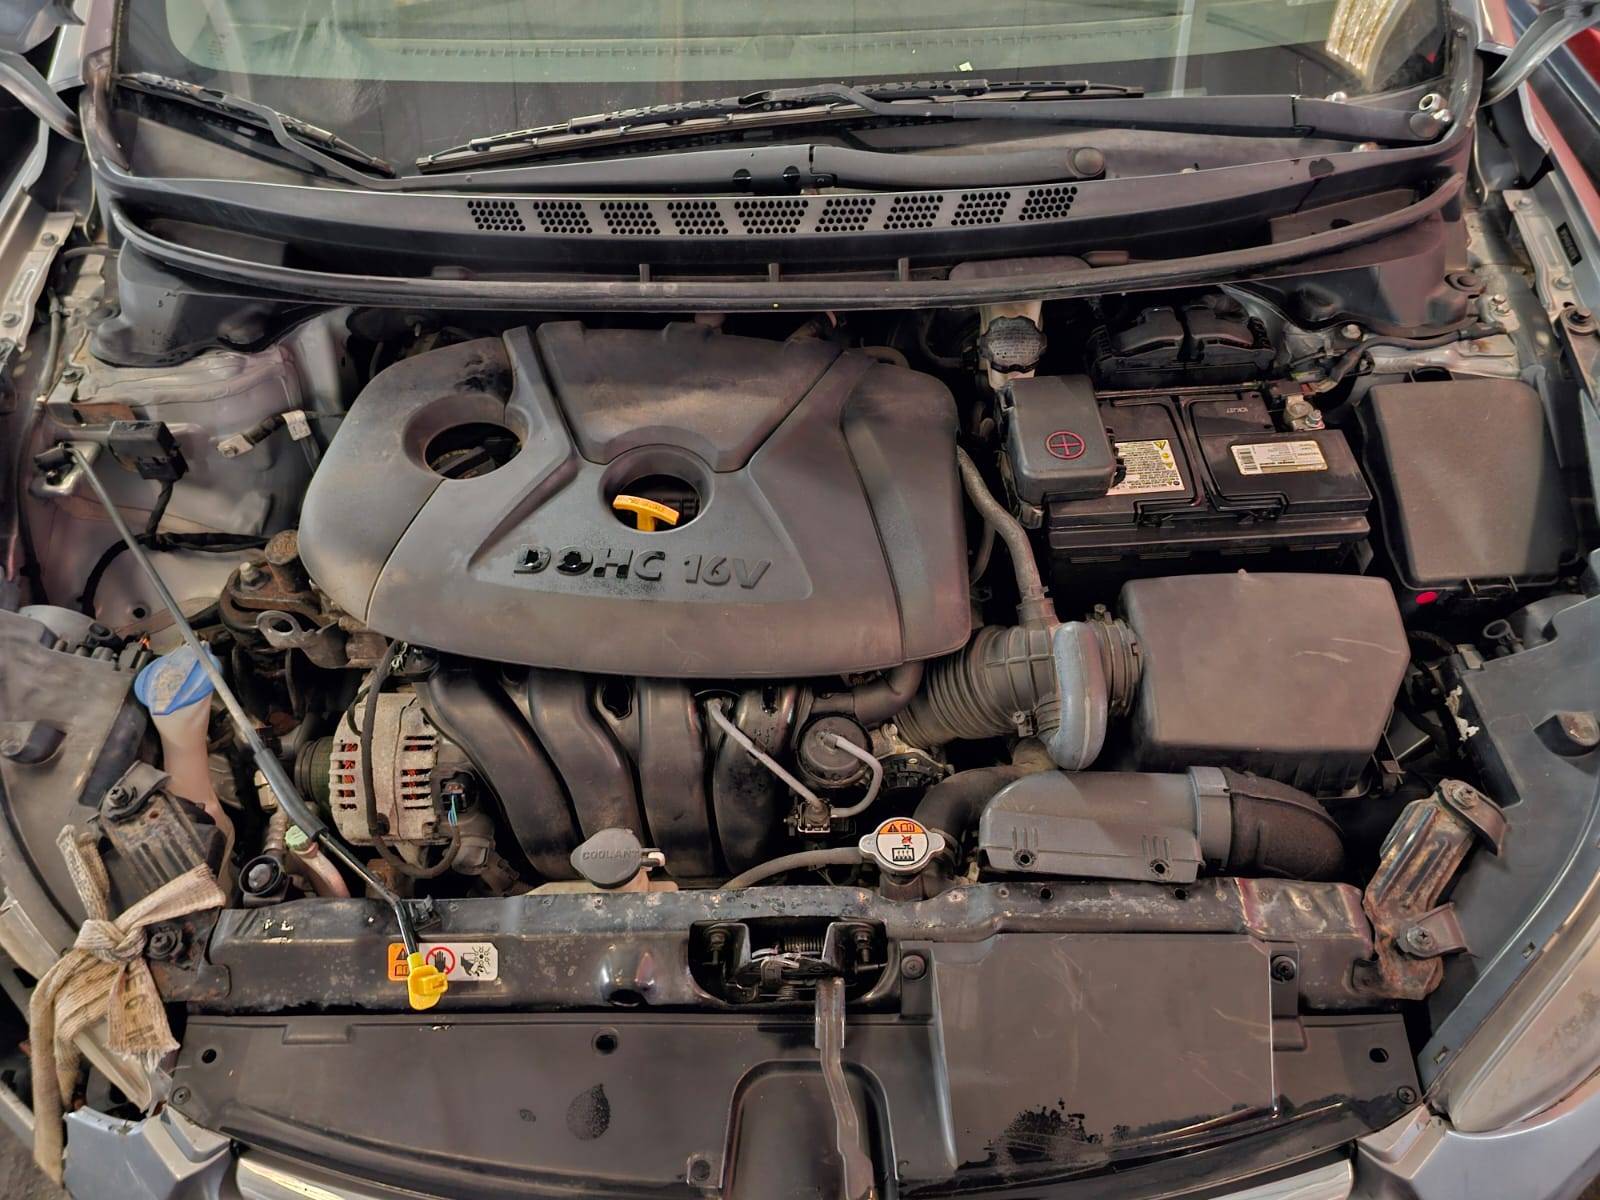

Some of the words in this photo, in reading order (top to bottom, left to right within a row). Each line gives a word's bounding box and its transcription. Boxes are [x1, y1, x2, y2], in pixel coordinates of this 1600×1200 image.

[514, 544, 665, 581] DOHC
[683, 554, 771, 589] 16V
[582, 849, 640, 860] COOLANT
